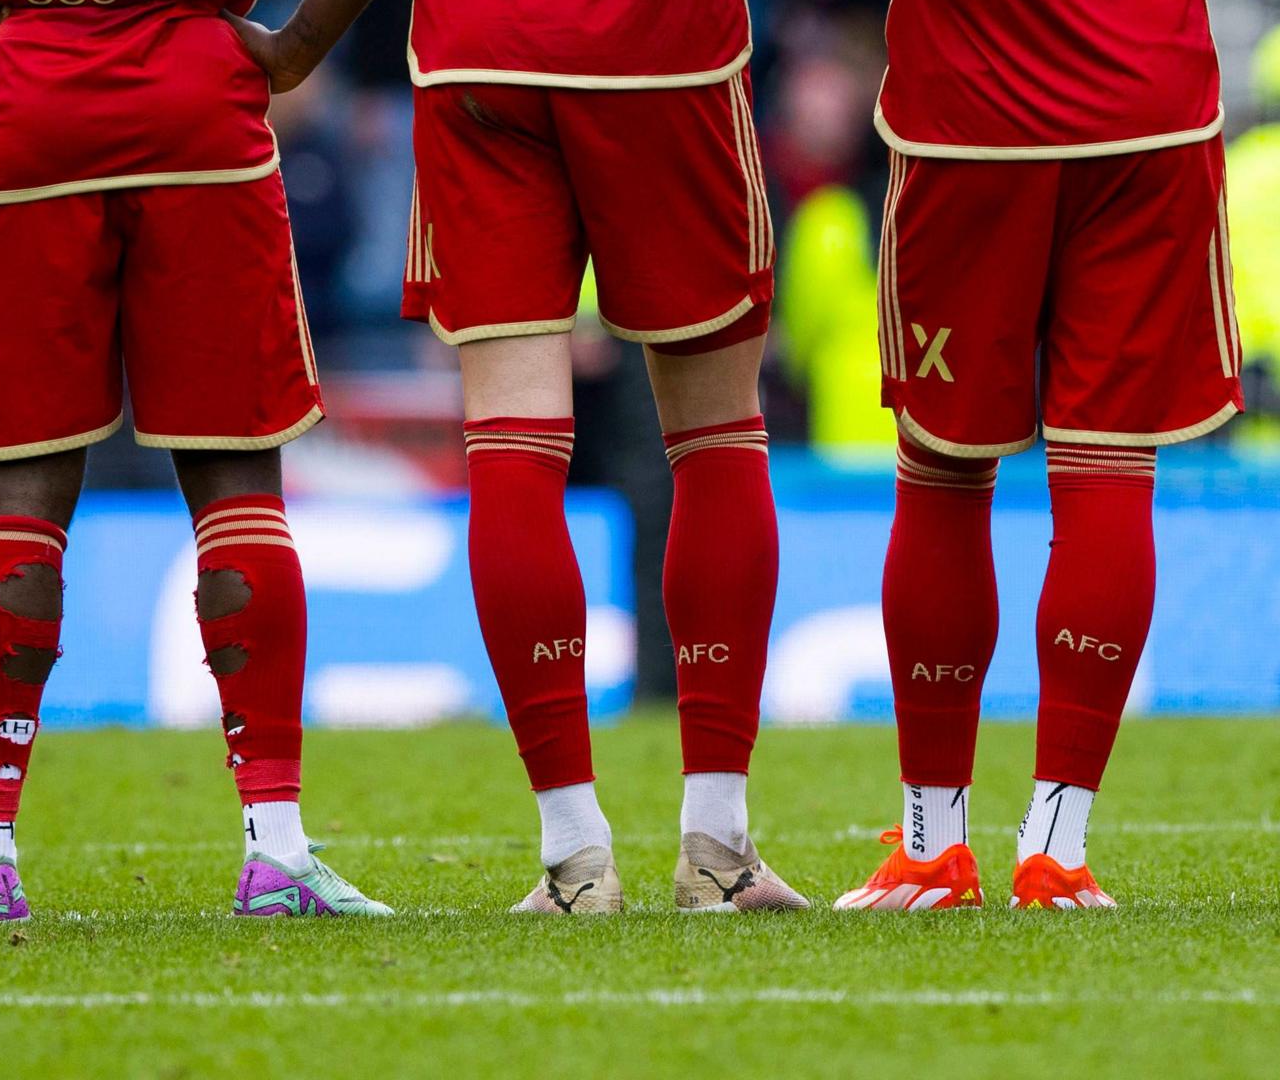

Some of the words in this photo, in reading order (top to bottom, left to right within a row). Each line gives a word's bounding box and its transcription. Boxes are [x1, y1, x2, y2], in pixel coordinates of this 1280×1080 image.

[533, 637, 583, 663] AFC
[678, 643, 730, 665] AFC
[1054, 628, 1122, 662] AFC
[911, 662, 975, 683] AFC
[912, 803, 926, 853] SOCKS
